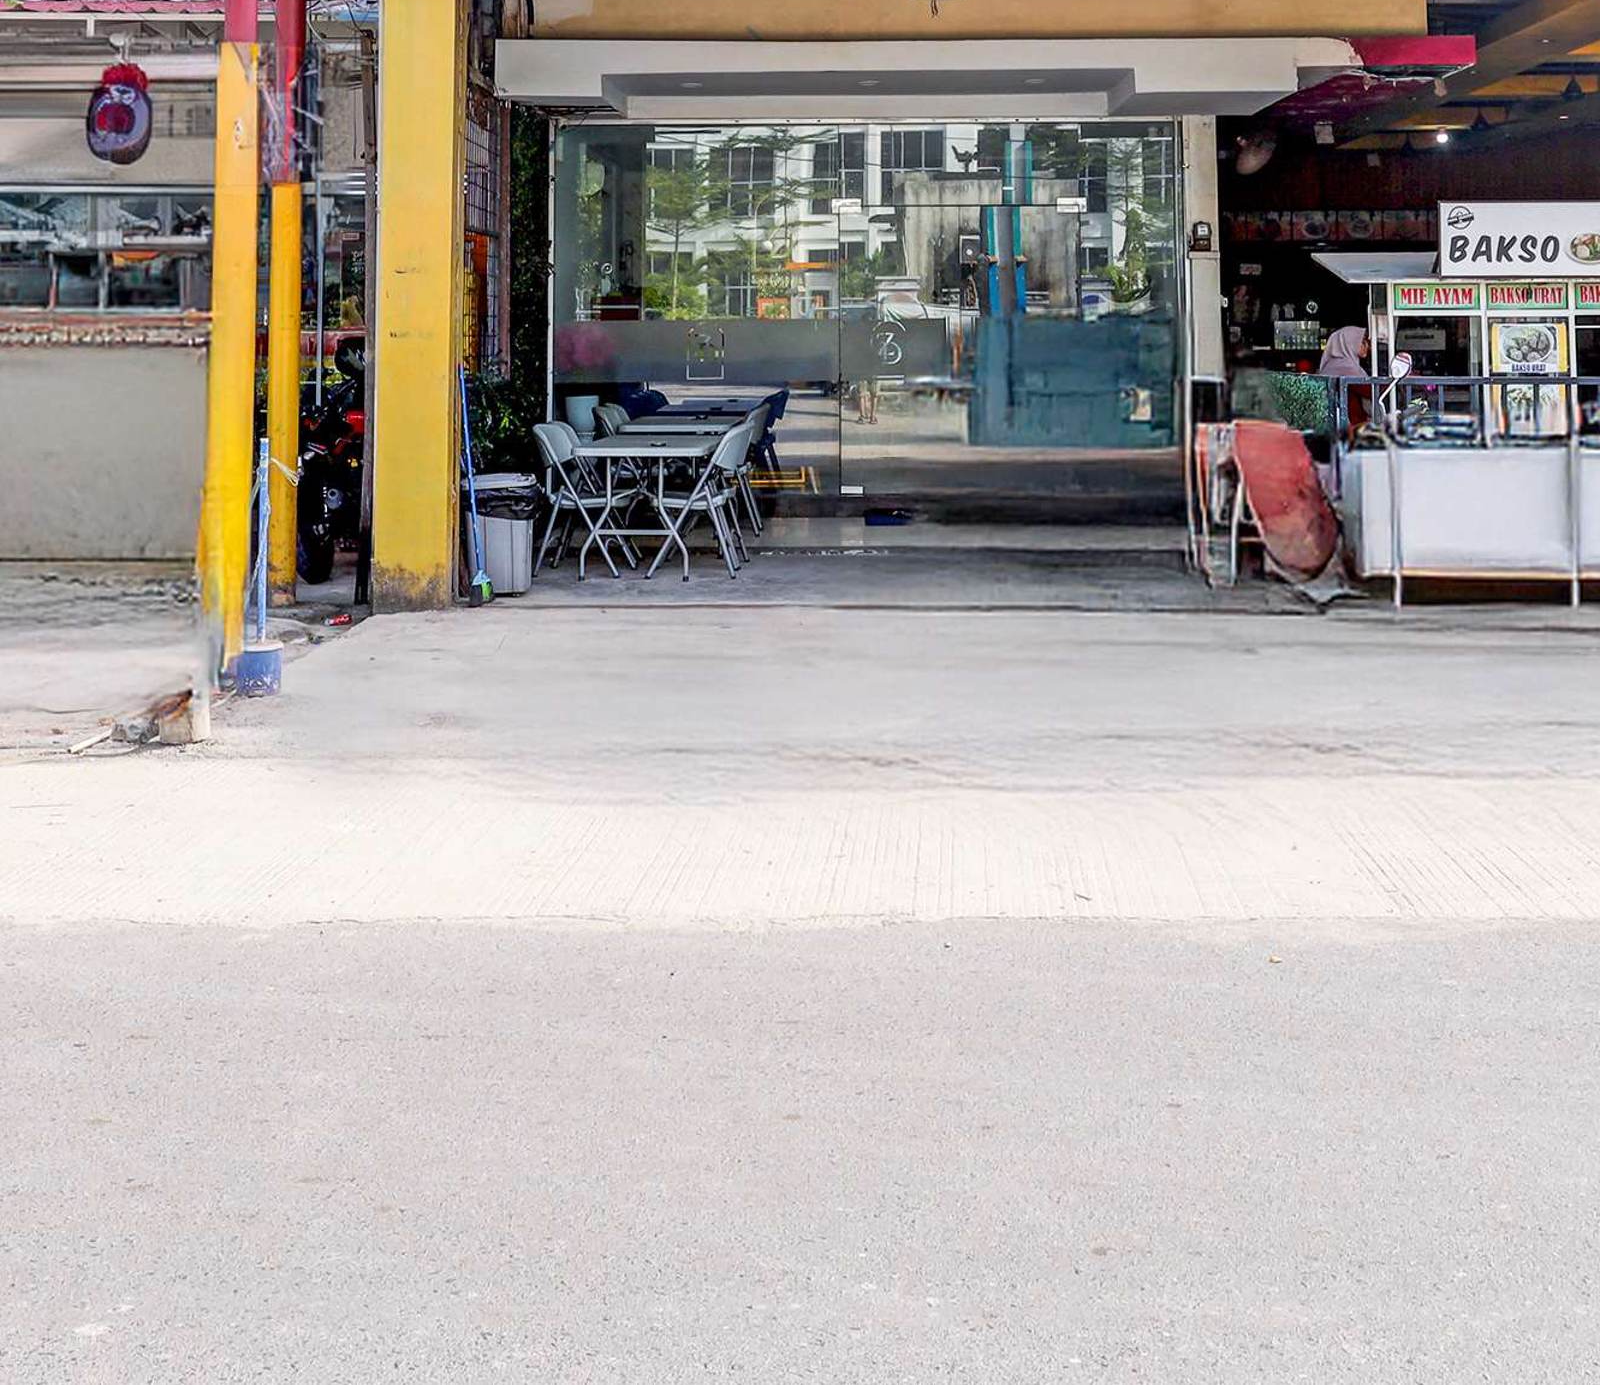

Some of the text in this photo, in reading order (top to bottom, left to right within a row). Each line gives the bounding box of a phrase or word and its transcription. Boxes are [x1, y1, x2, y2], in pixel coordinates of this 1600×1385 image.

[1449, 235, 1560, 263] BAKSO
[1401, 287, 1474, 305] MIE AYAM
[1491, 287, 1564, 304] BAKSO URAT
